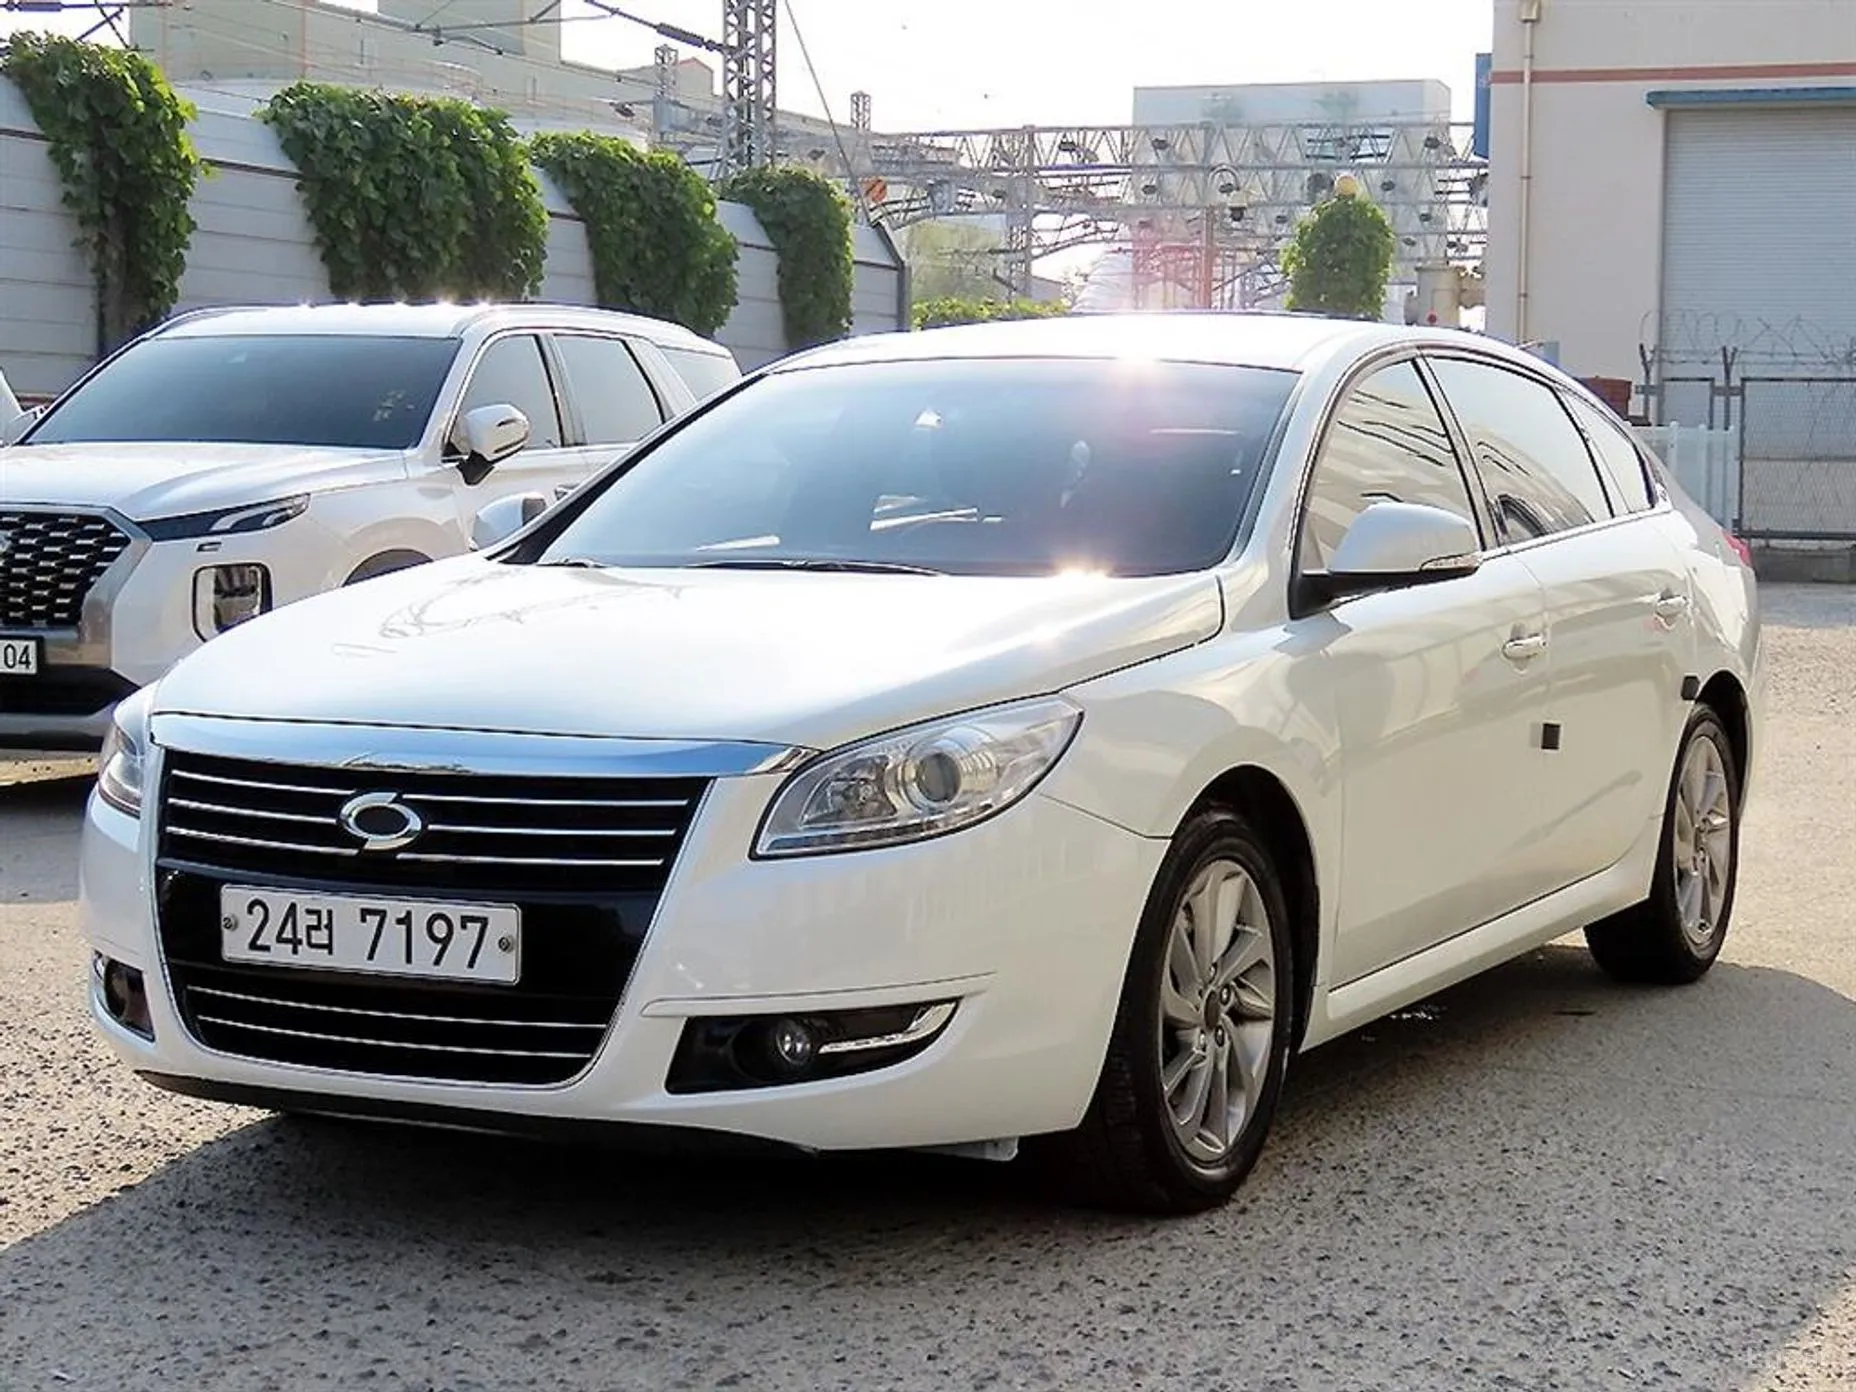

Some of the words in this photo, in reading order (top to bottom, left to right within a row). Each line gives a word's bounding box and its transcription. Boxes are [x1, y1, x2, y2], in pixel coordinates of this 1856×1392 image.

[3, 644, 31, 669] 04
[246, 898, 334, 956] 24러
[359, 907, 489, 969] 7197
